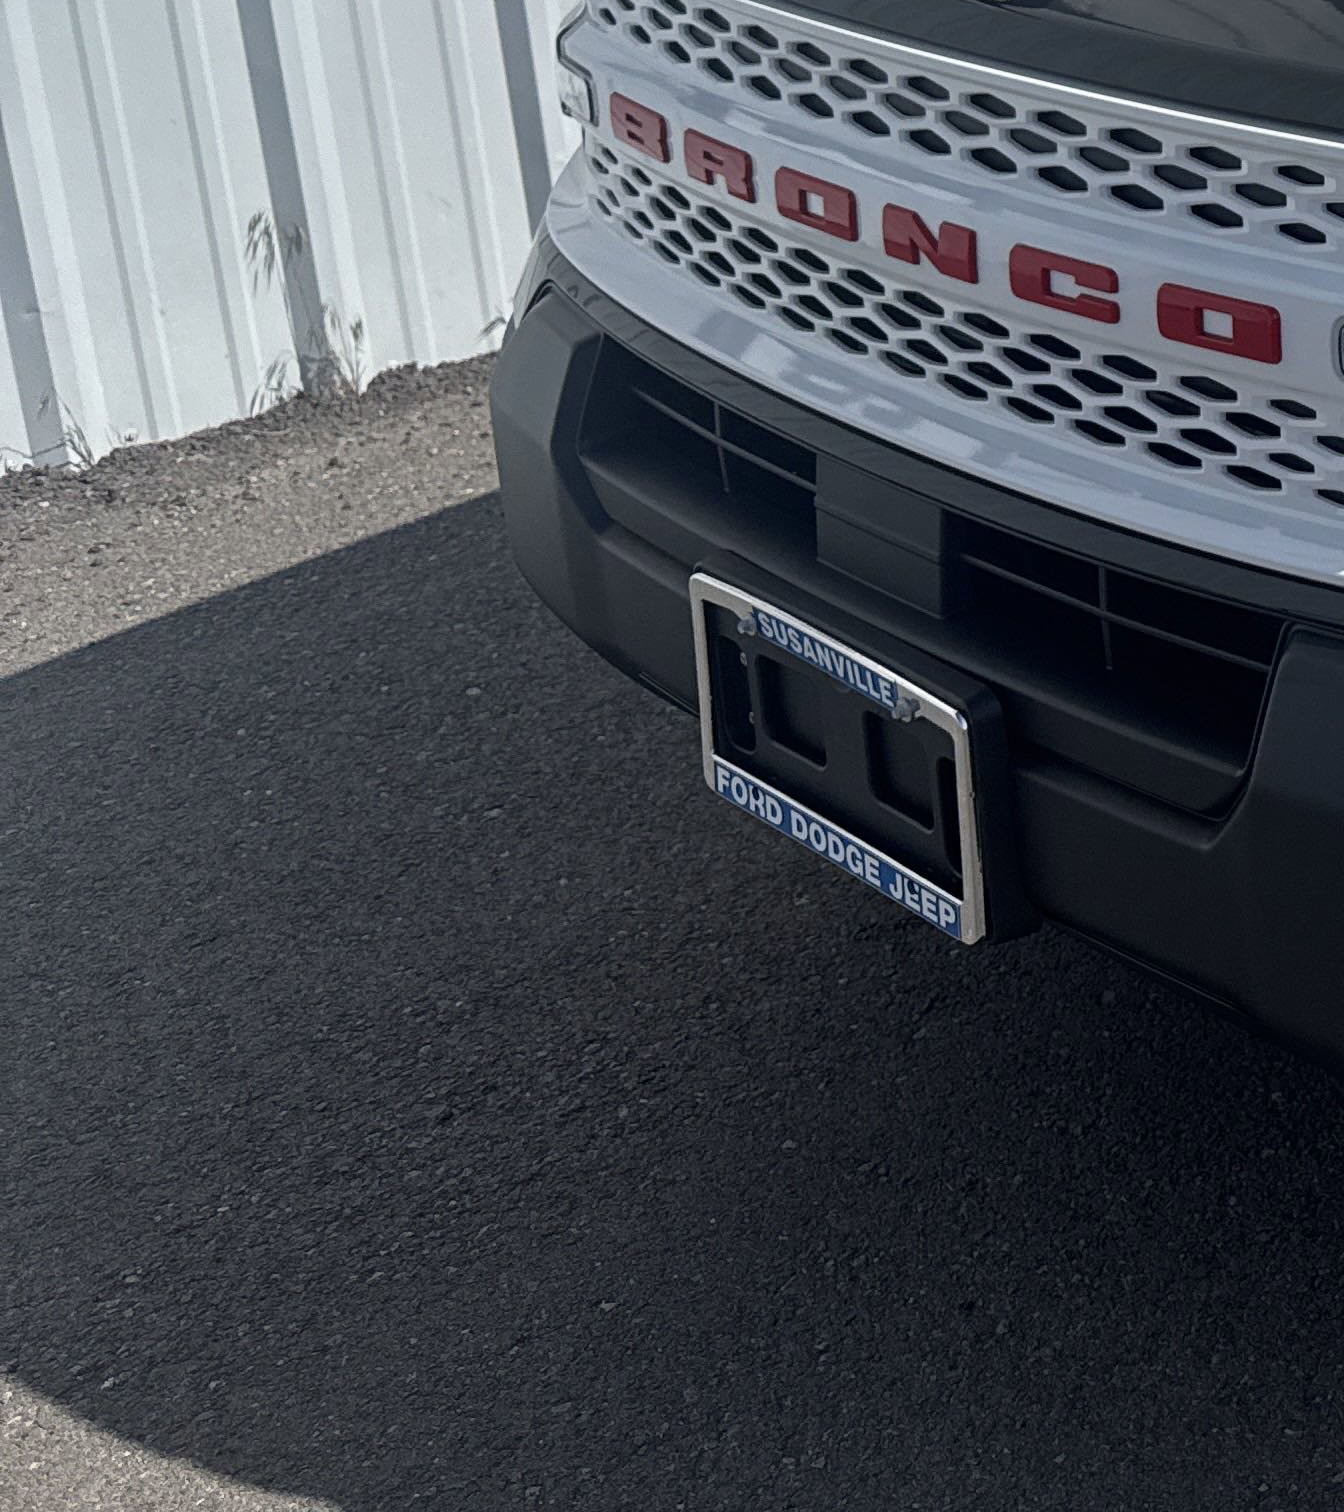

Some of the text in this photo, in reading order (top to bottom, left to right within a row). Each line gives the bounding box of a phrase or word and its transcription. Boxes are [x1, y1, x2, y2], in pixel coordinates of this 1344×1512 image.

[609, 91, 1283, 365] BRONCO
[757, 612, 896, 708] SUSANVILLE
[716, 766, 957, 928] FORD DODGE JEEP
